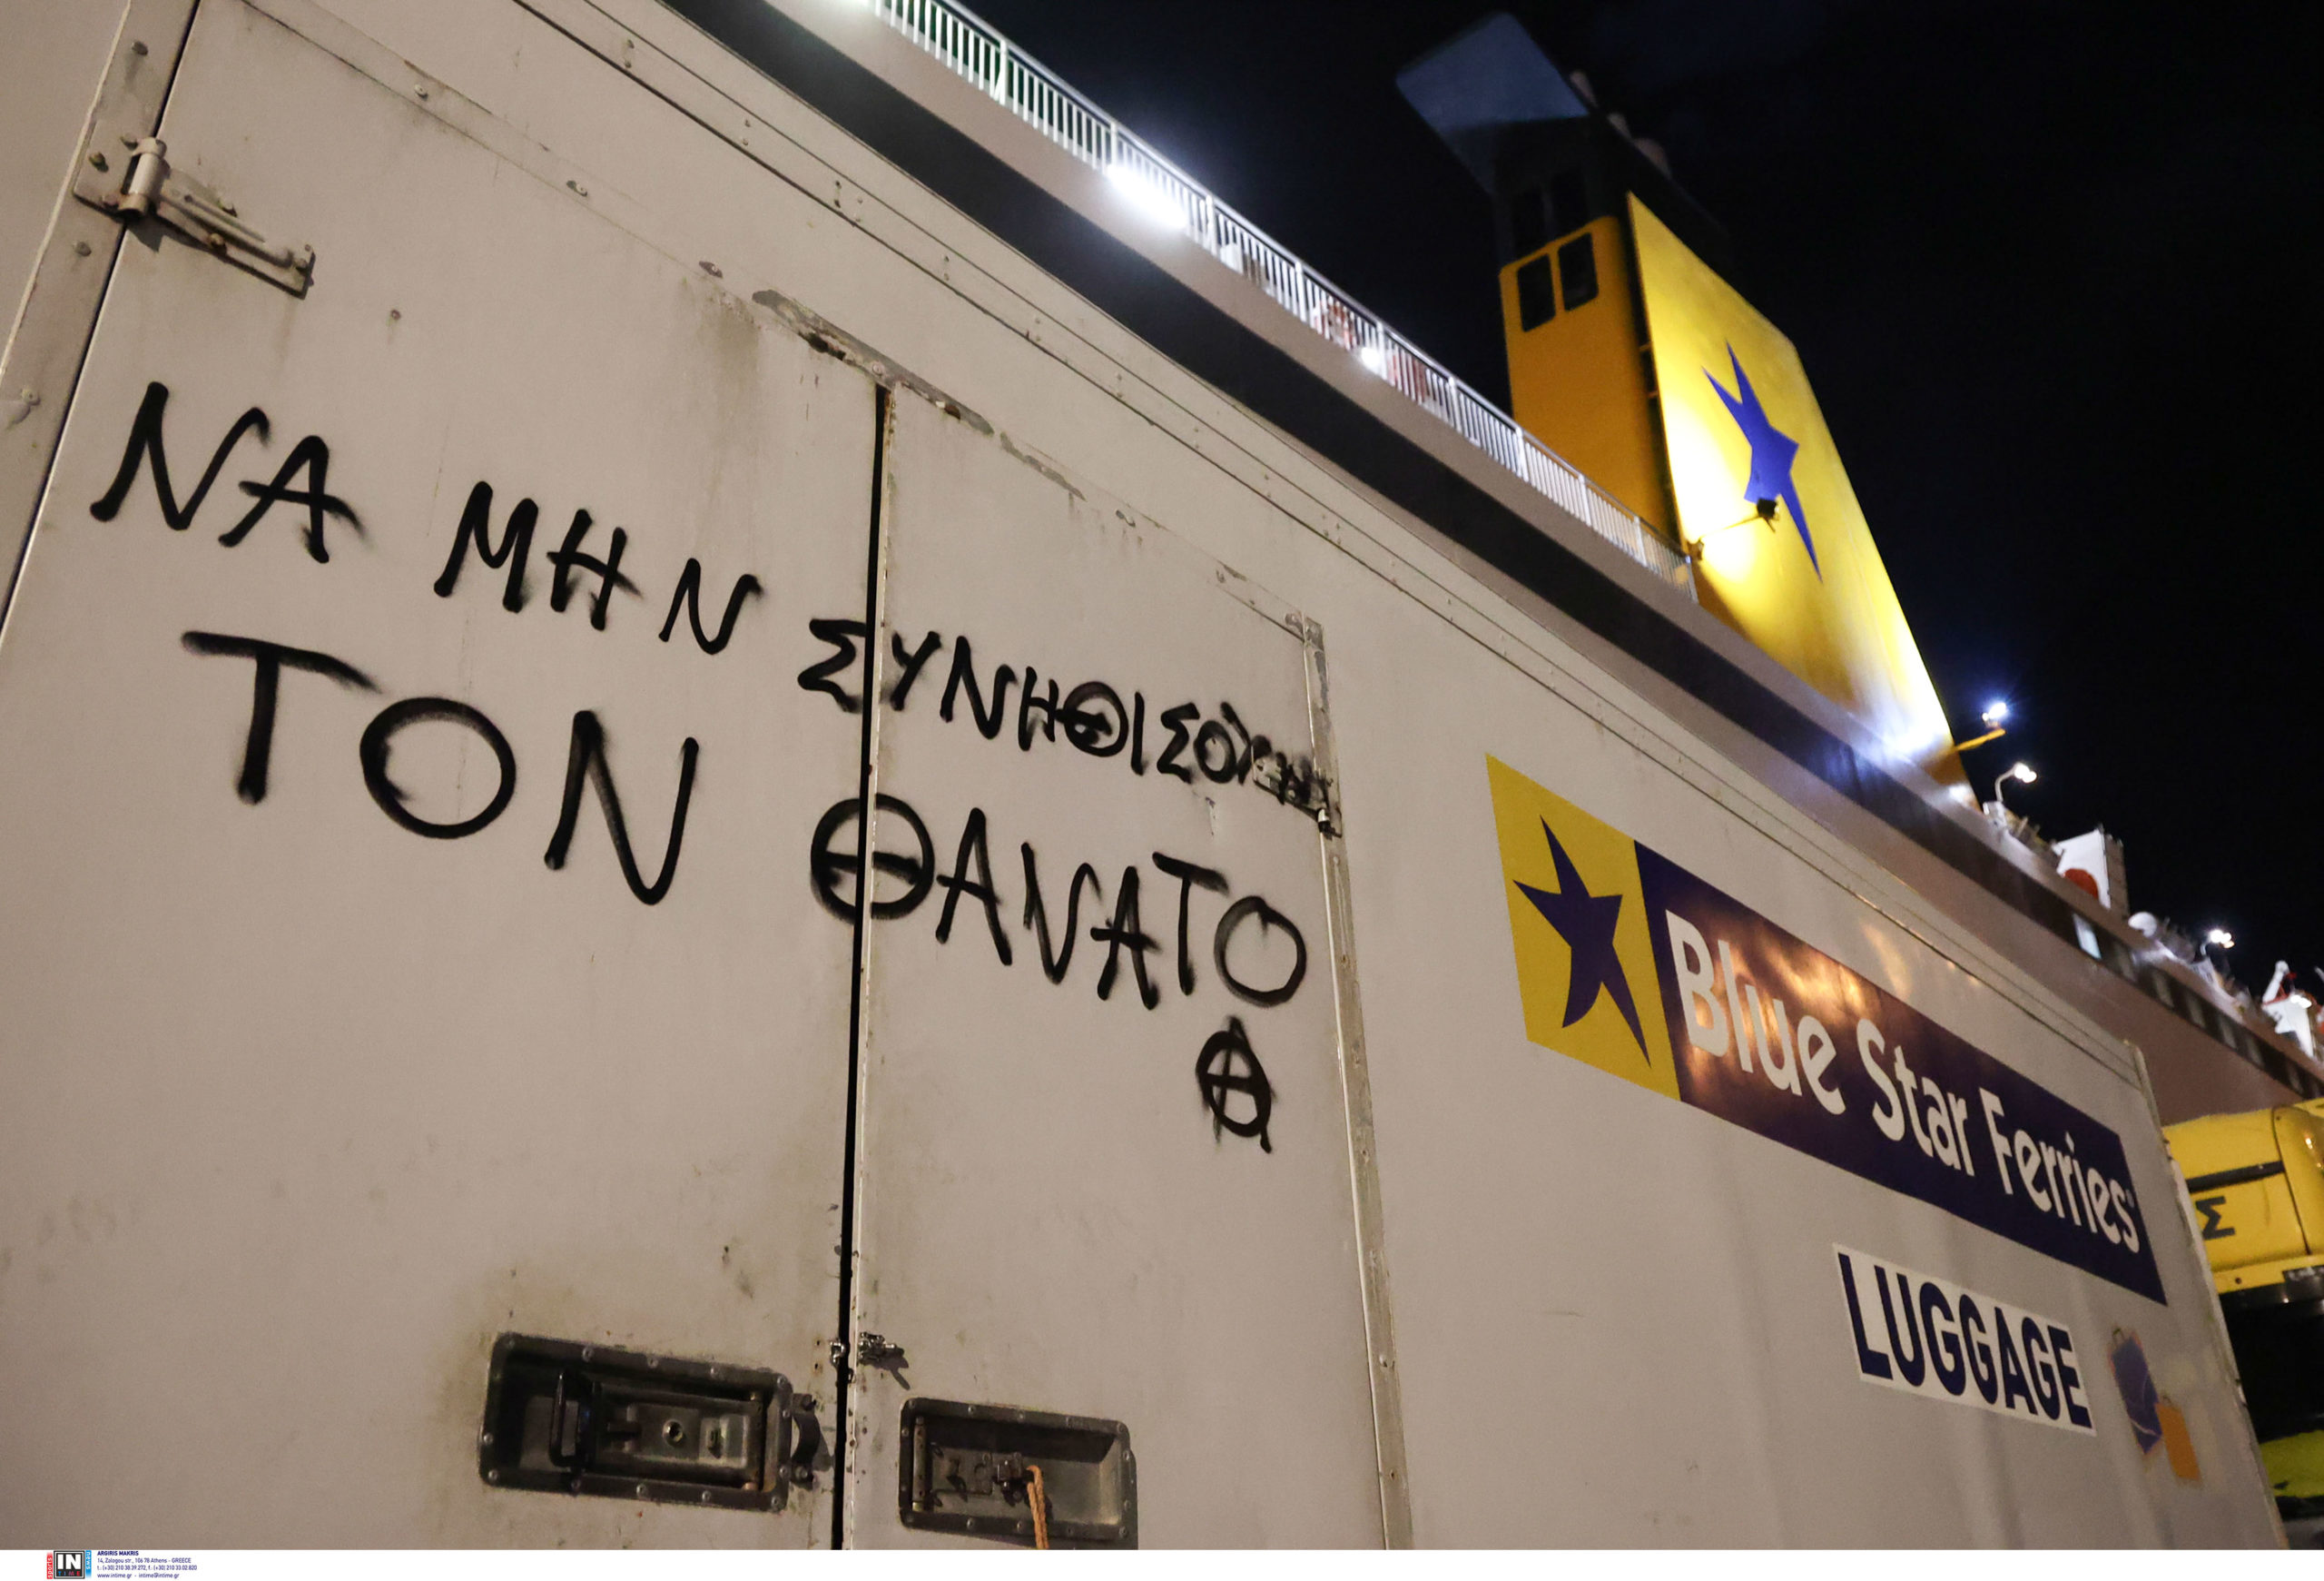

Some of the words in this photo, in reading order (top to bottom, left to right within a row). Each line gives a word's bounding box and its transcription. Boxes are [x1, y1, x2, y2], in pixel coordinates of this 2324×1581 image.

[89, 380, 365, 565] ΝΑ
[433, 480, 764, 657] ΜΗΝ
[181, 630, 701, 906] ΤΟΝ
[810, 790, 1309, 1012] ΘΑΝΑΤΟ
[1666, 910, 1846, 1116] Blue
[1856, 1018, 1976, 1177] Star
[1838, 1252, 2092, 1429] LUGGAGE
